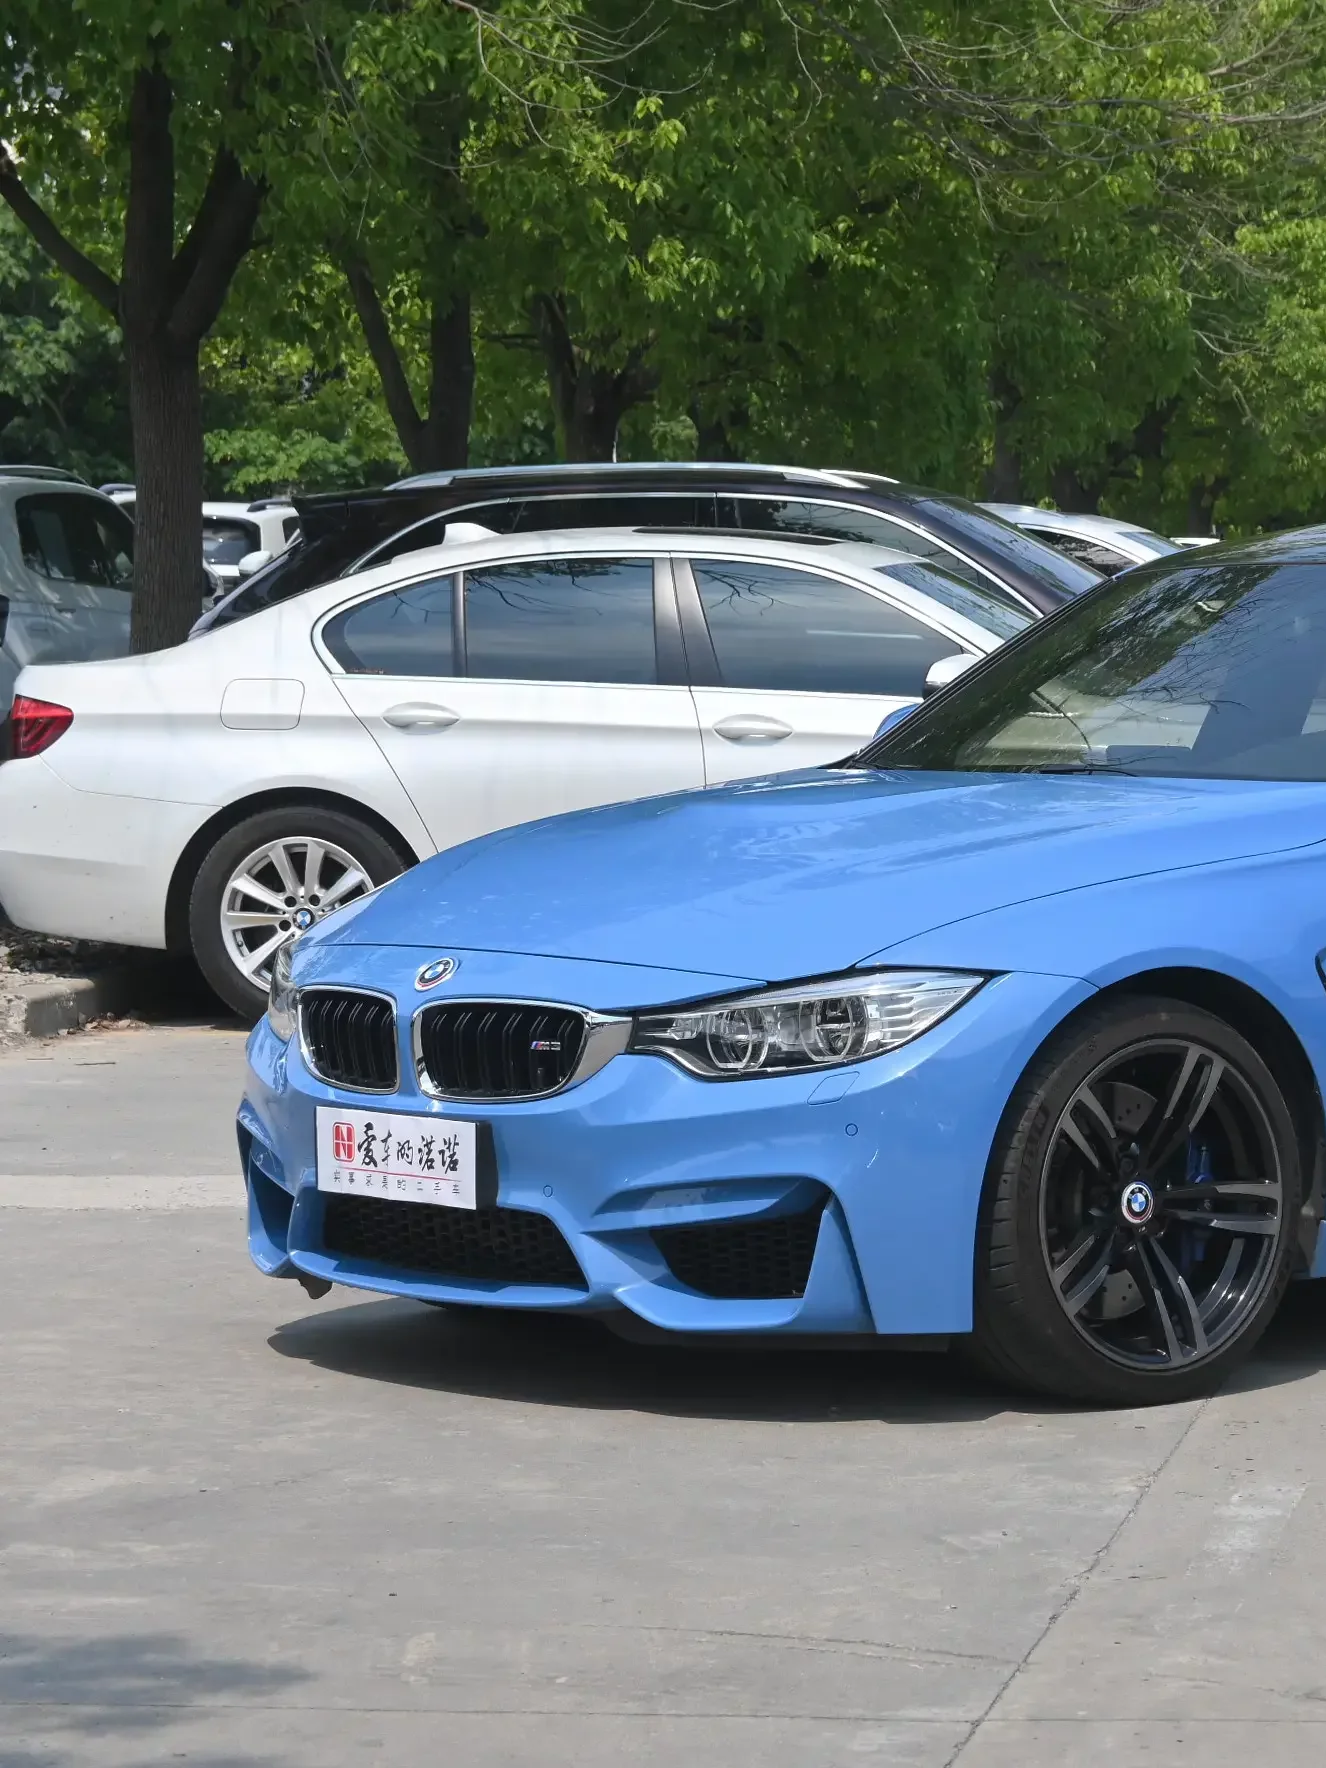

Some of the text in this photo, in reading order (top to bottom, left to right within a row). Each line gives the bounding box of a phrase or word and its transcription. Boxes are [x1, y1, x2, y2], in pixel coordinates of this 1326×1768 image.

[358, 1122, 460, 1175] 爱车的诺诺
